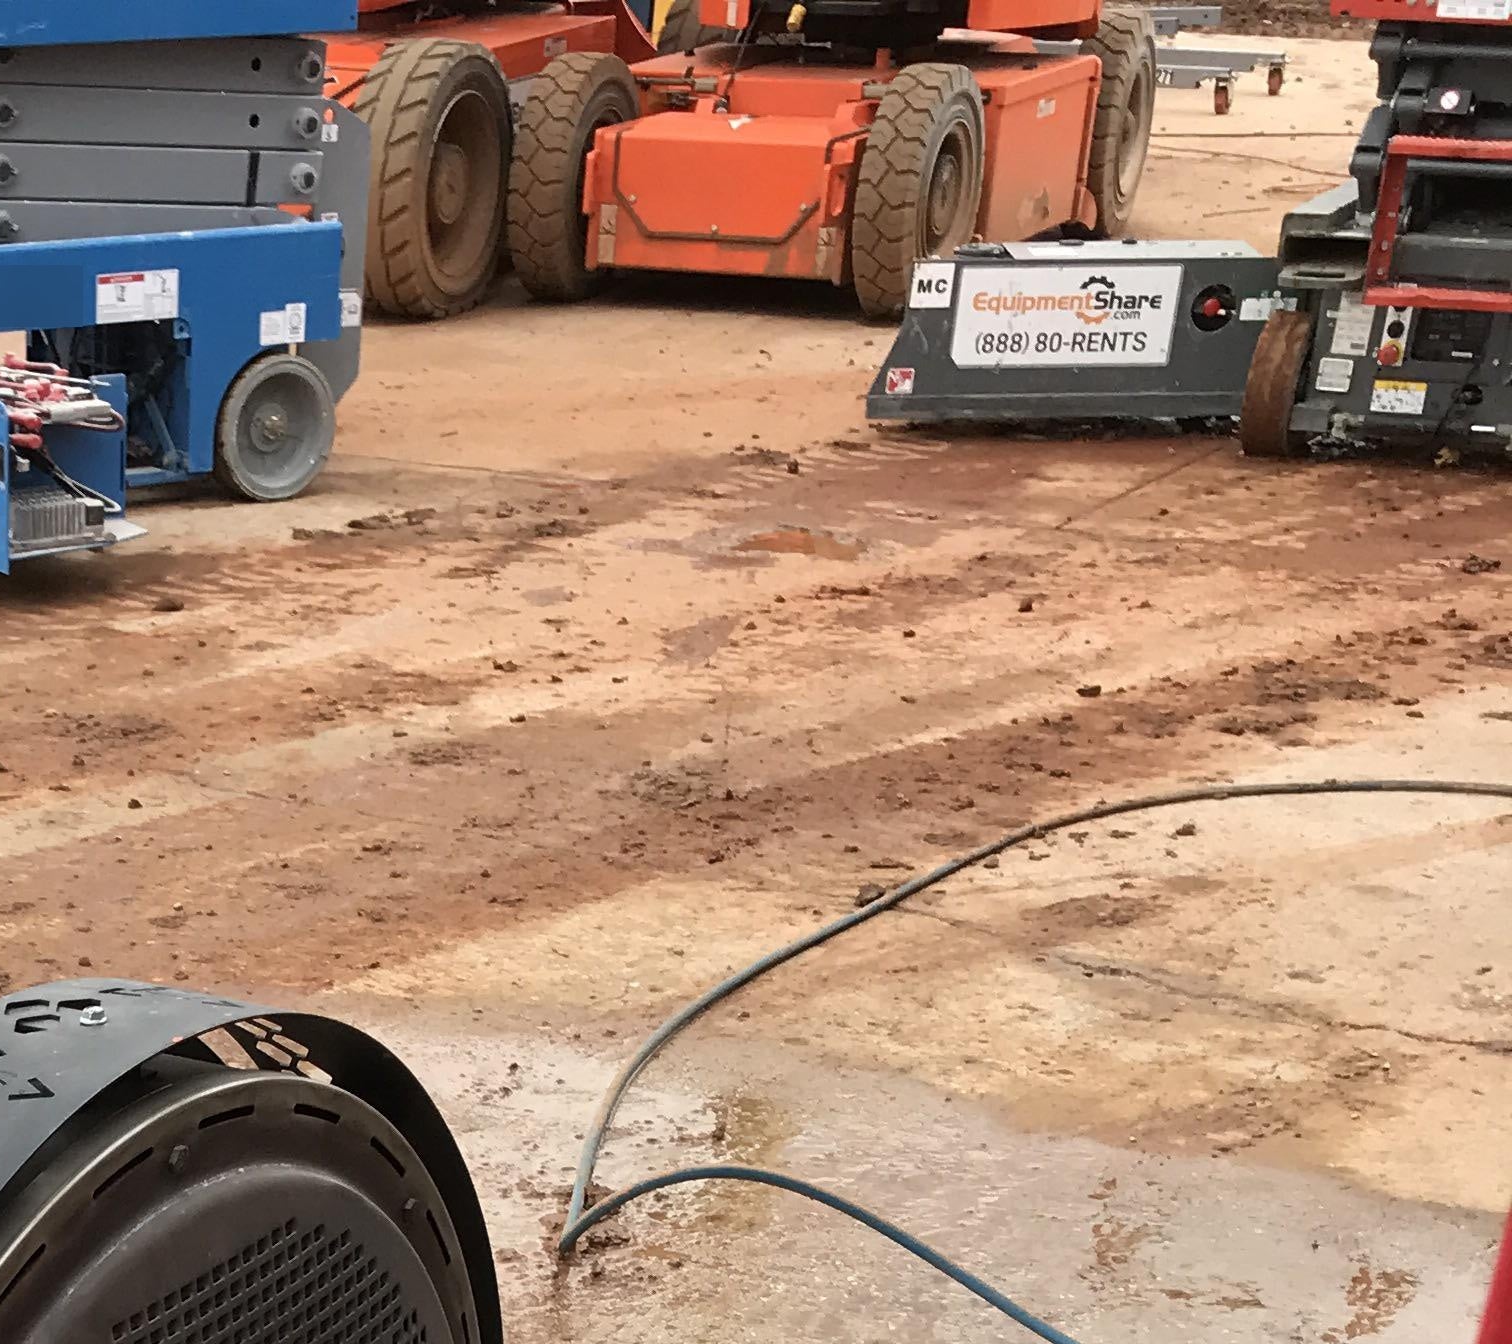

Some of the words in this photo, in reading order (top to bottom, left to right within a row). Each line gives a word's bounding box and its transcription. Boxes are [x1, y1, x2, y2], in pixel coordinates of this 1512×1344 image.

[917, 279, 948, 294] MC
[972, 290, 1163, 315] EquipmentShare
[1110, 309, 1141, 320] .com
[975, 331, 1030, 356] (888)
[1034, 331, 1148, 353] 80-RENTS
